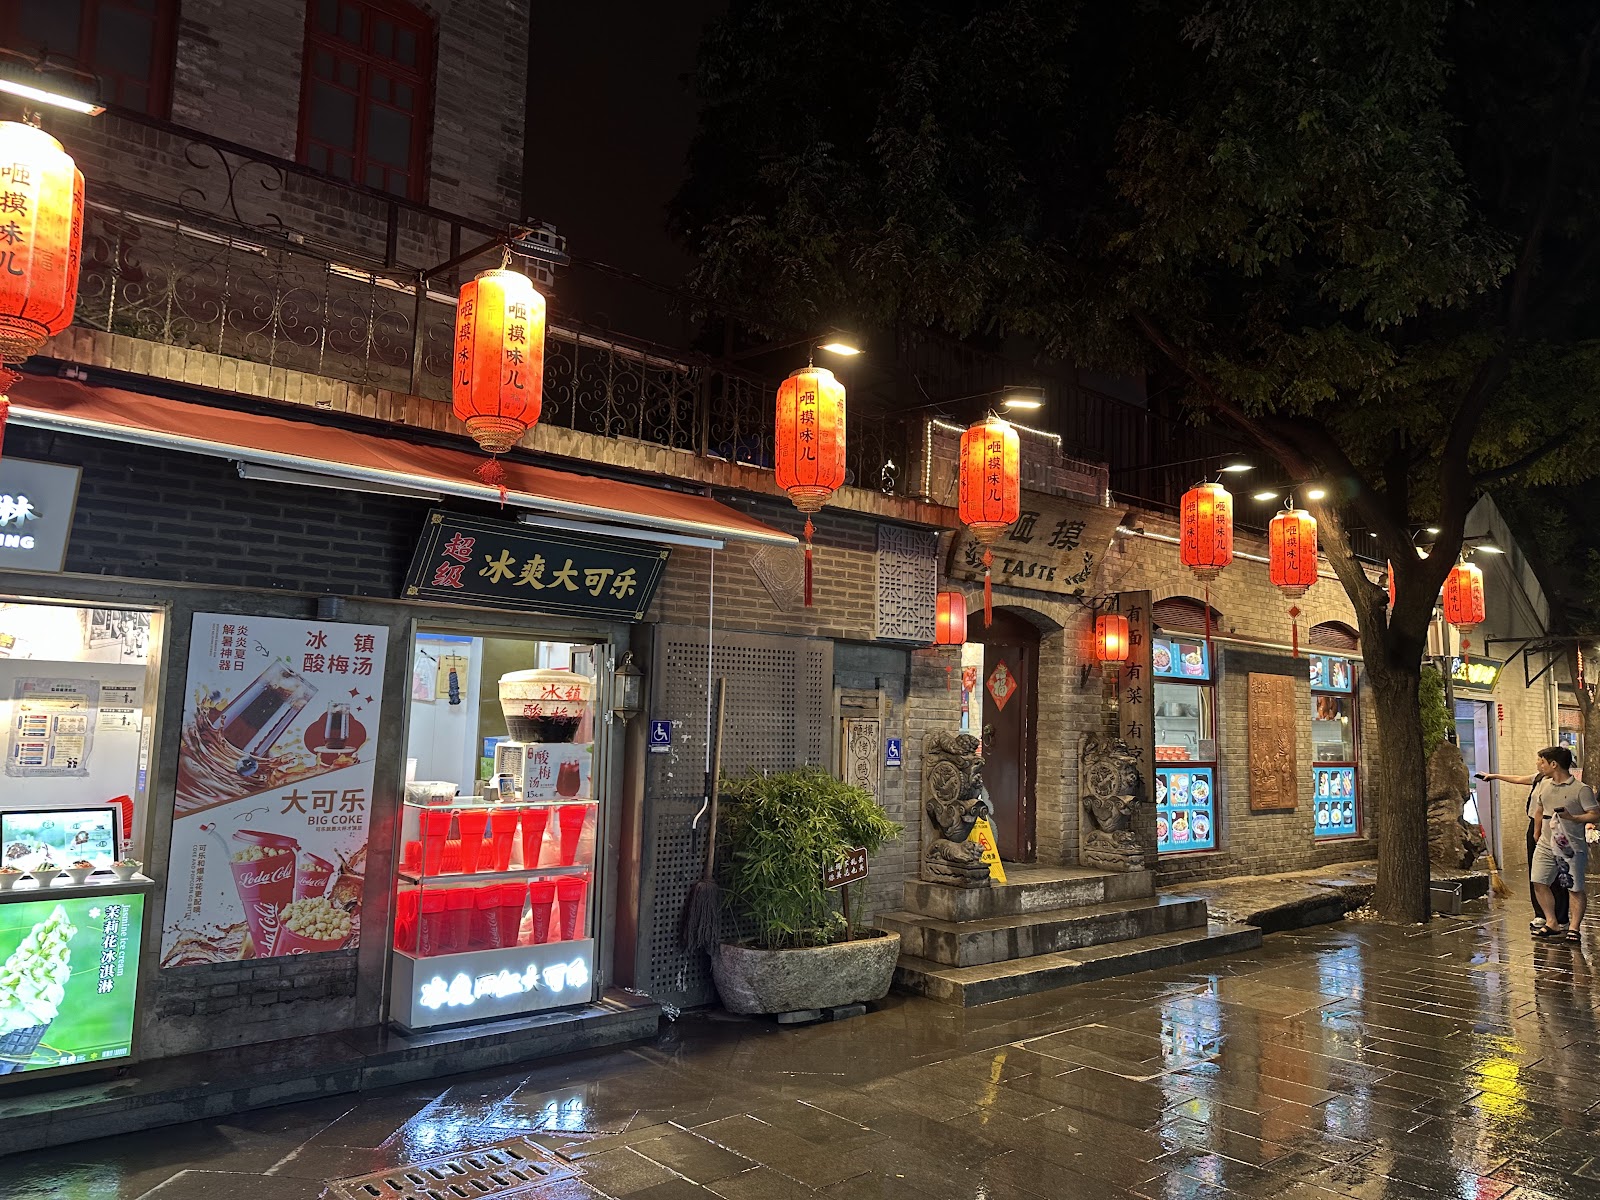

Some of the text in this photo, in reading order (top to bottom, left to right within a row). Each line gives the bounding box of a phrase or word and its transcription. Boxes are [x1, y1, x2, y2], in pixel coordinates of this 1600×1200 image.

[0, 162, 31, 276] 咂摸味儿
[456, 298, 474, 388] 咂摸味儿
[504, 302, 527, 390] 咂摸味儿
[799, 390, 816, 461] 咂摸味儿
[986, 440, 1002, 502] 咂摸味儿
[1186, 502, 1197, 550] 咂摸味儿
[1215, 501, 1226, 550] 咂摸味儿
[1285, 525, 1298, 571] 咂摸味儿
[432, 532, 476, 589] 超级
[478, 549, 638, 599] 冰爽大可乐
[1002, 558, 1057, 581] TASTE
[219, 624, 235, 671] 解暑神器
[234, 625, 248, 671] 炎炎夏日
[1126, 604, 1143, 646] 有面
[303, 653, 373, 676] 酸梅汤
[1126, 662, 1143, 704] 有菜
[541, 684, 583, 705] 冰镇
[280, 788, 366, 815] 大可乐
[307, 815, 363, 825] BIG COKE
[97, 904, 121, 994] 茉莉花冰淇淋
[117, 904, 131, 976] Jasmine ice cream
